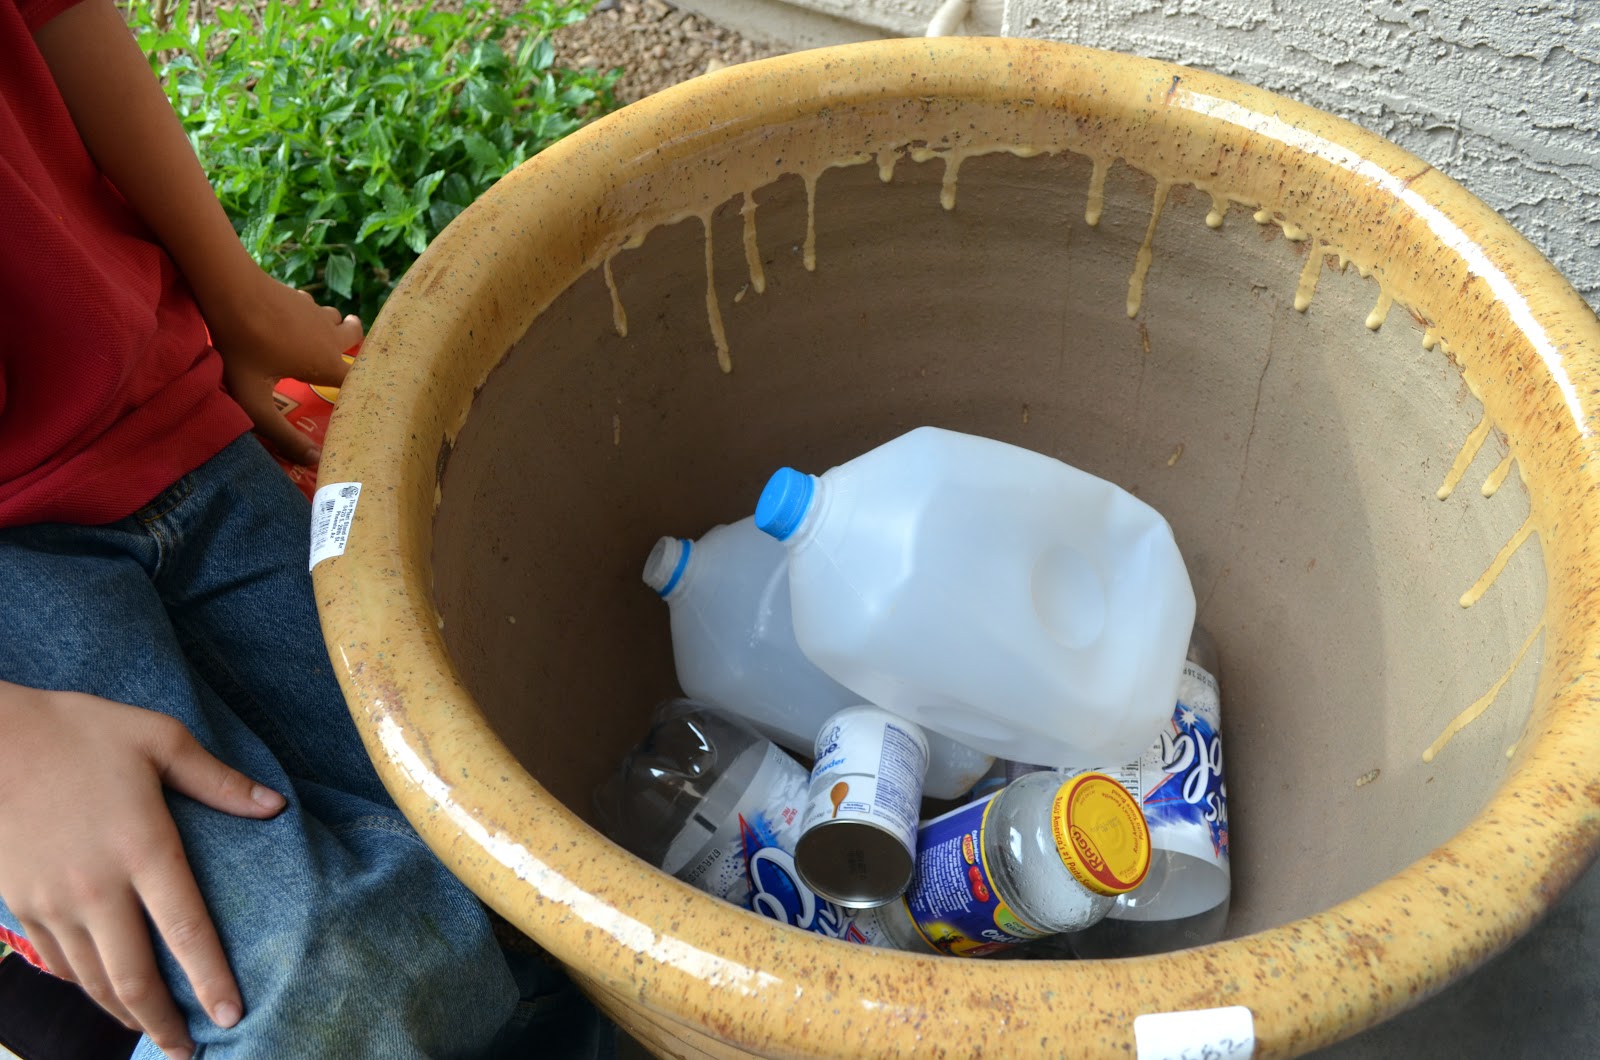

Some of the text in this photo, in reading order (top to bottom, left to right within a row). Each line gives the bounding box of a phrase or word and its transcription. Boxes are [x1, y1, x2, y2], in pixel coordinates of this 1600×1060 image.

[1160, 727, 1223, 804] ola
[1053, 815, 1064, 850] America's
[1067, 862, 1082, 879] Pasta
